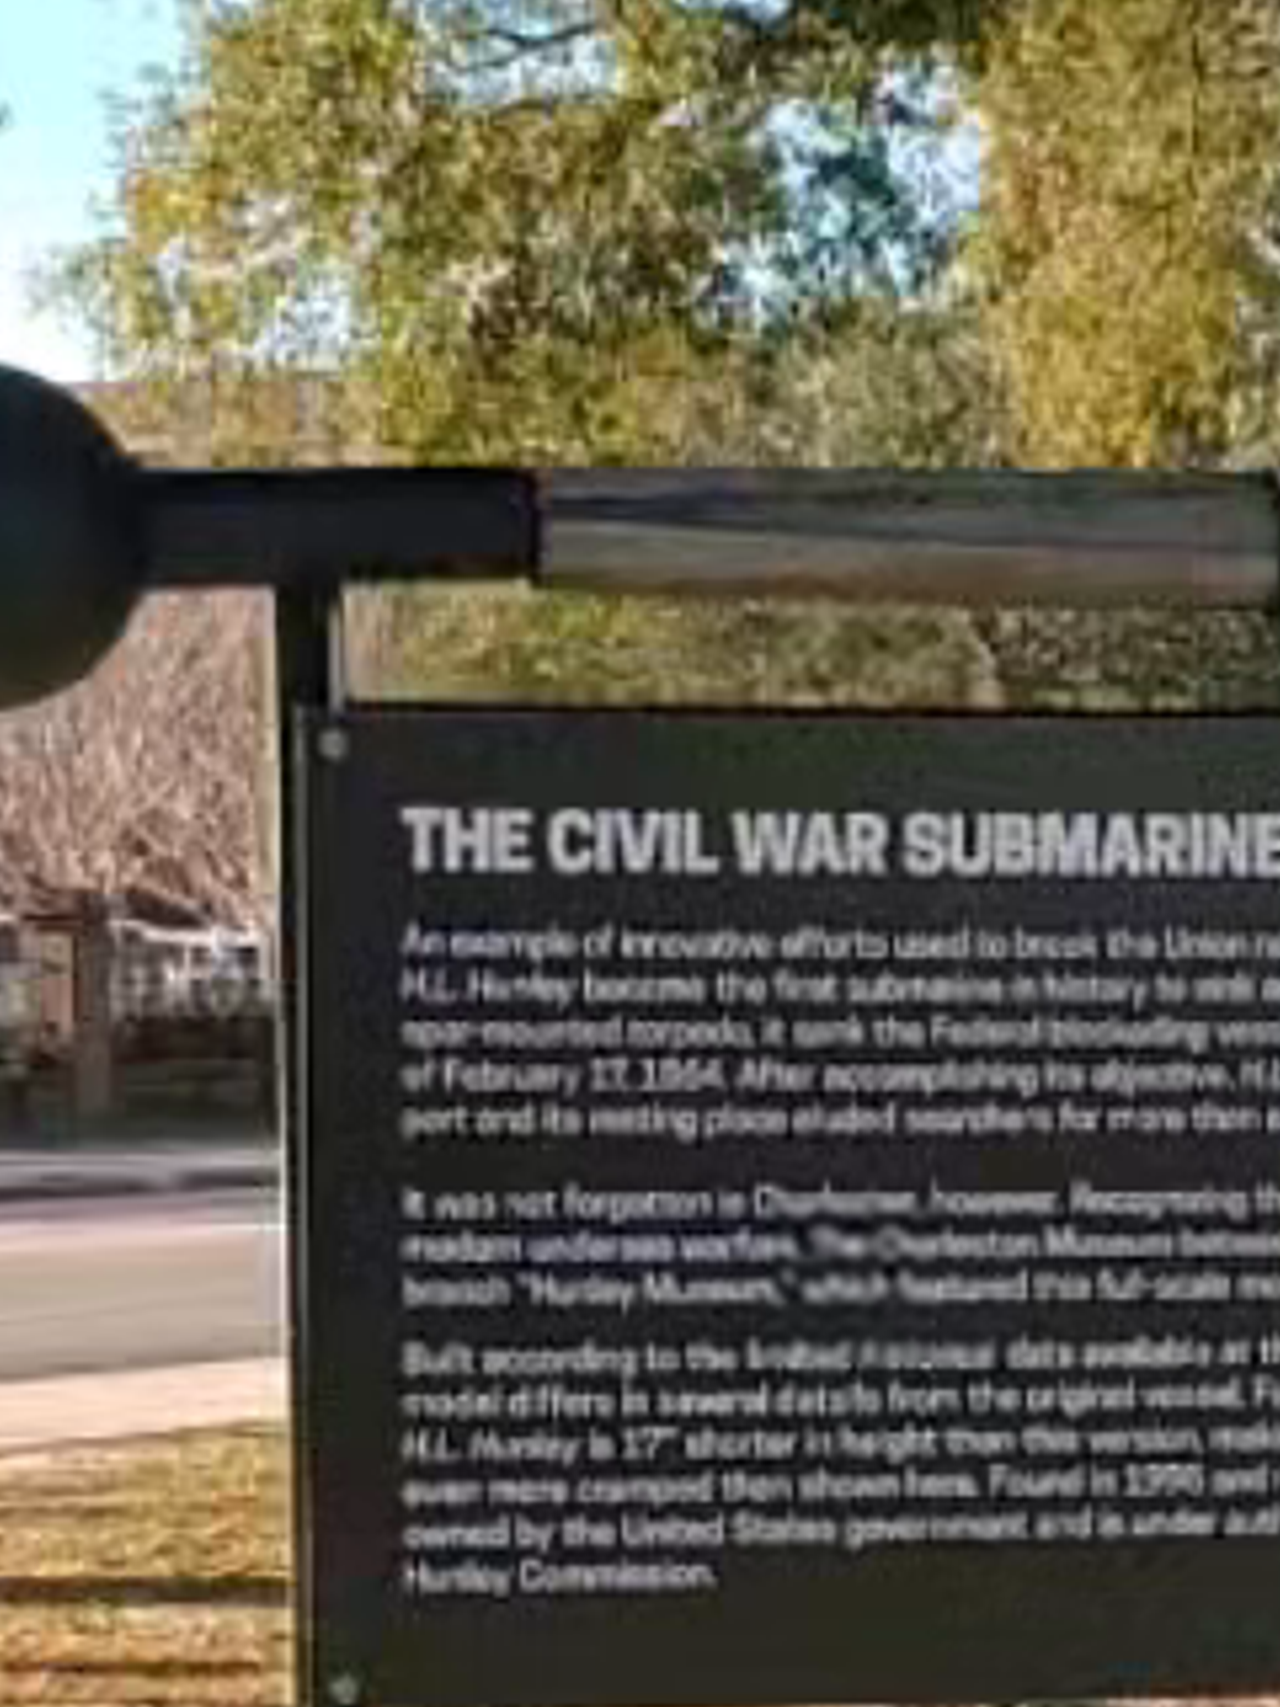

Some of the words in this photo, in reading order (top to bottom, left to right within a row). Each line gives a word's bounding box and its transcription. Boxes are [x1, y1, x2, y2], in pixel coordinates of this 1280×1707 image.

[399, 807, 533, 873] THE
[545, 807, 719, 874] CIVIL
[730, 809, 890, 875] WAR
